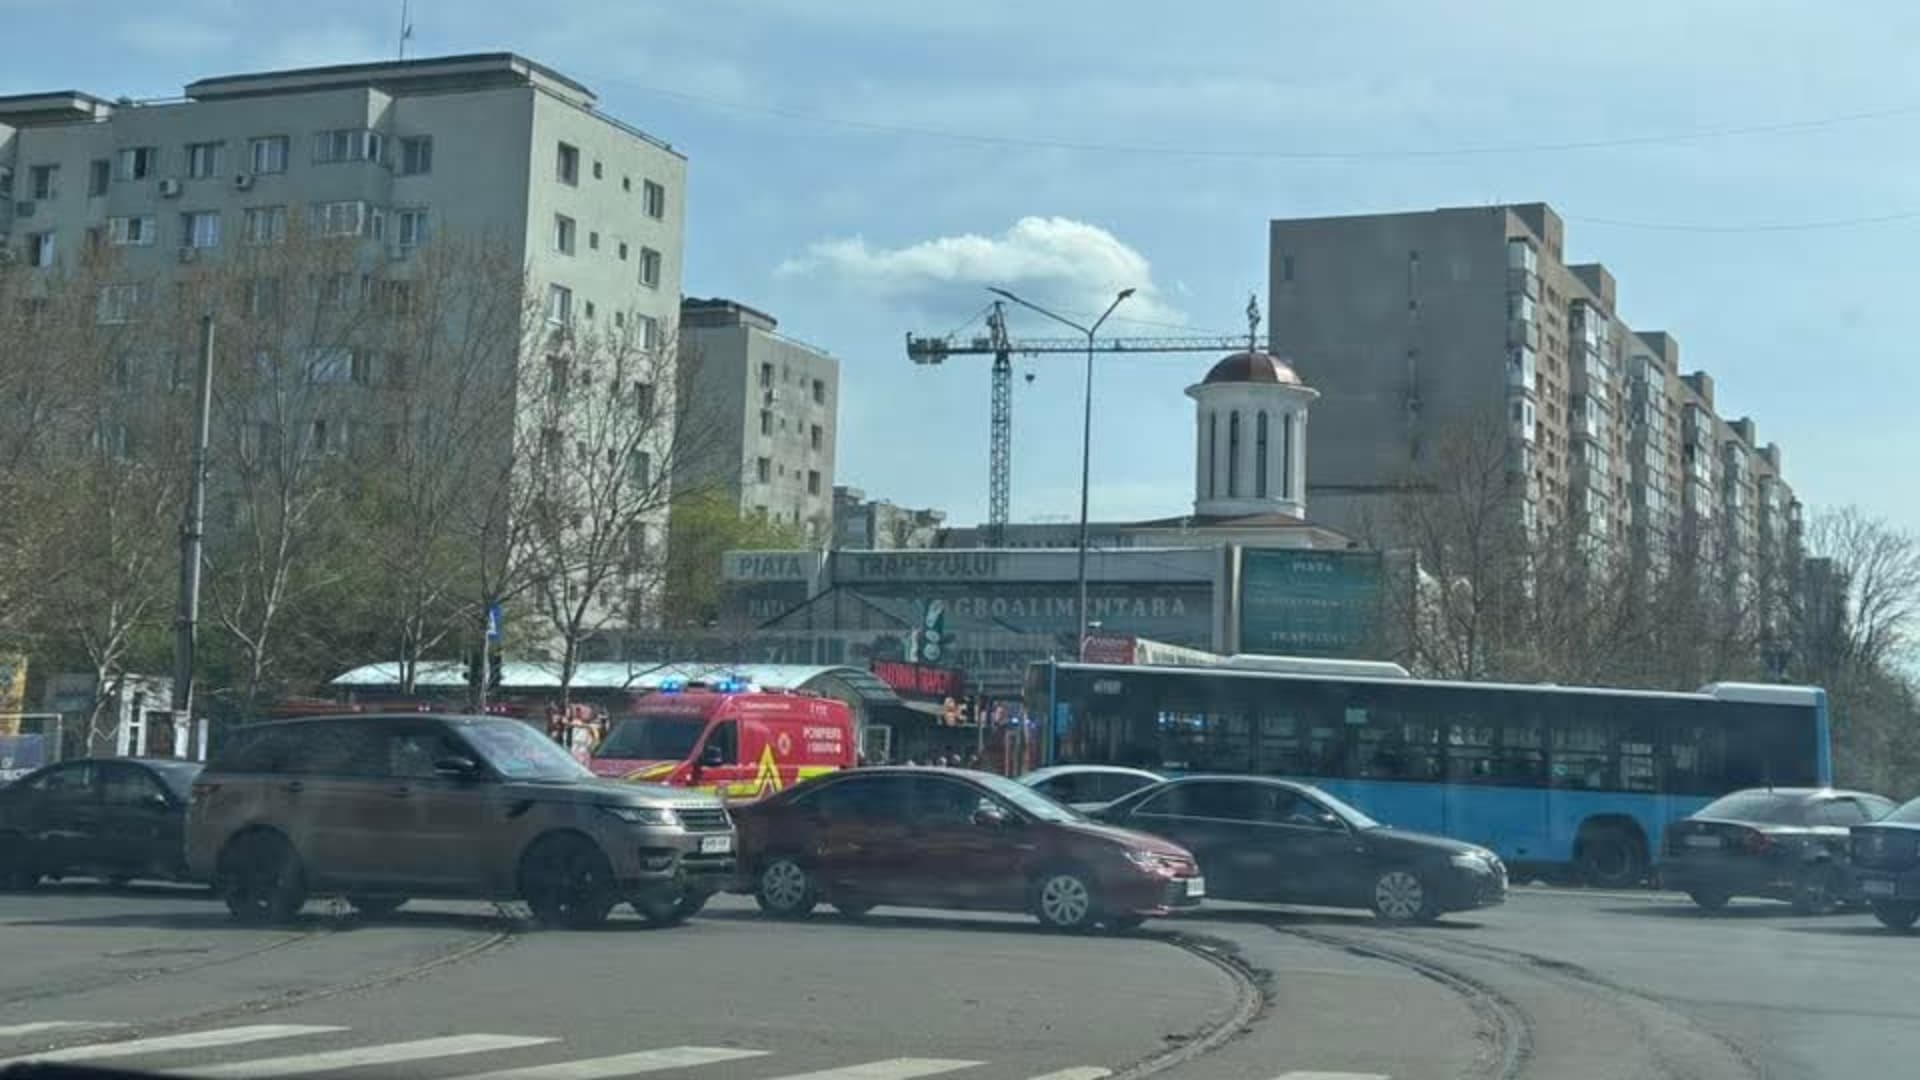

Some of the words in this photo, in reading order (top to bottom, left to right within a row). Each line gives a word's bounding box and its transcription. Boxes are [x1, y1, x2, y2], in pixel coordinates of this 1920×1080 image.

[739, 556, 801, 576] PIATA
[856, 555, 998, 578] TRAPEZULUI
[944, 597, 1186, 617] GROALIMNTARA
